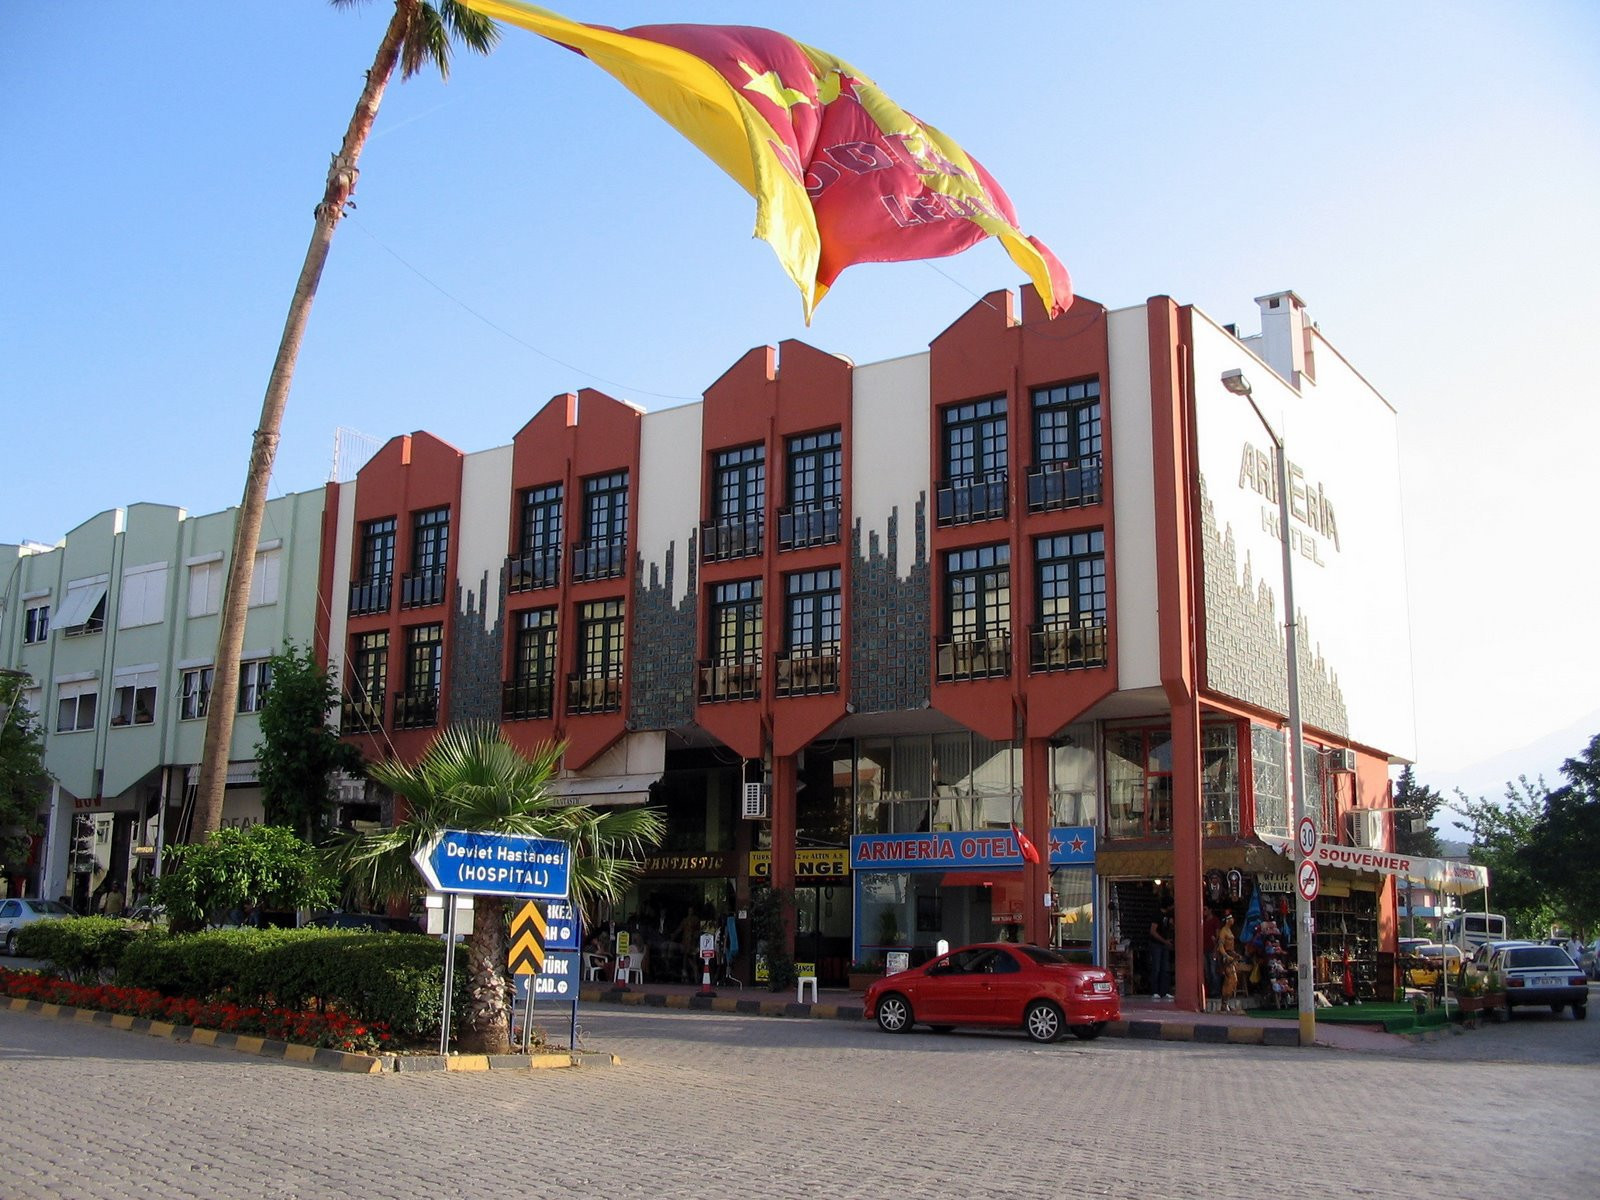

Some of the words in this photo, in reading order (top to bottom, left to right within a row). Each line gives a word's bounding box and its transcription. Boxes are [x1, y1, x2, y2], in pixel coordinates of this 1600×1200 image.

[1300, 828, 1314, 846] 30
[446, 842, 493, 860] Devlet
[496, 844, 564, 866] Hastanesi
[959, 837, 1019, 859] OTEL
[754, 862, 844, 875] CNGE
[1318, 848, 1411, 872] SOUVENIER
[547, 904, 572, 920] RKEZ
[545, 926, 558, 941] AH
[542, 955, 569, 974] TÜRK
